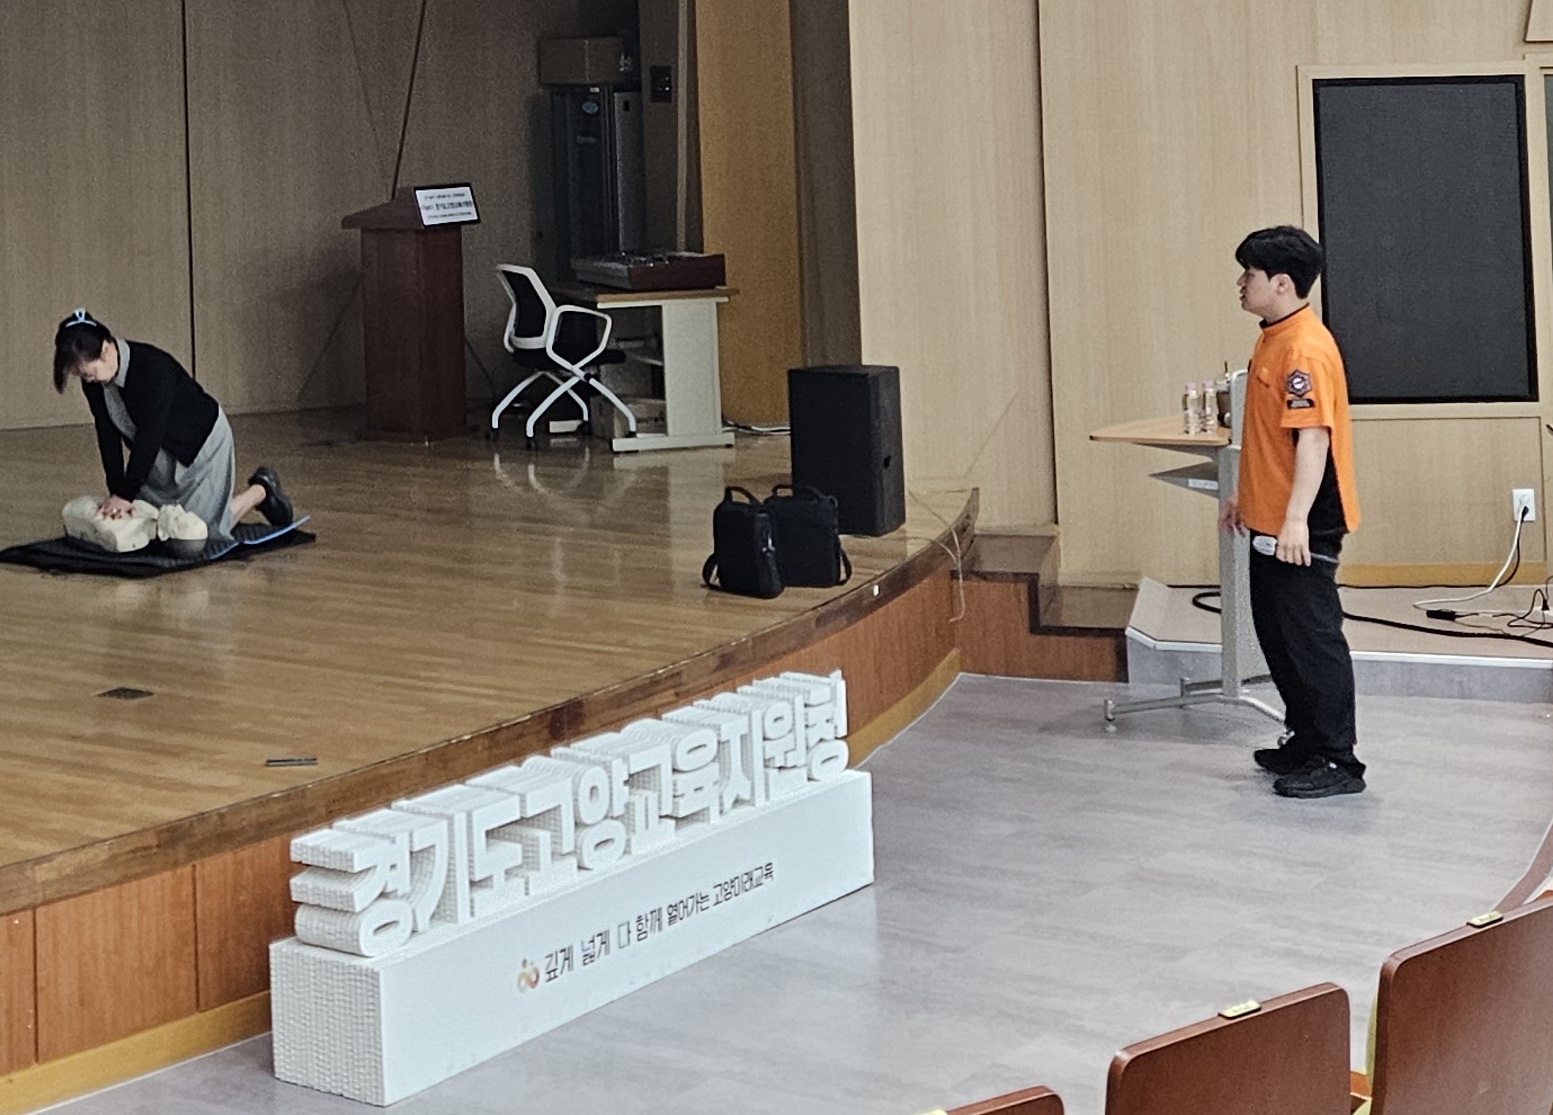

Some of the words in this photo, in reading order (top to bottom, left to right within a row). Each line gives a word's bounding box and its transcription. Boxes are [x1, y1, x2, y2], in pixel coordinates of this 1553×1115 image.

[290, 670, 851, 958] 경기도고양교육지원청
[545, 944, 574, 983] 깊게
[580, 929, 611, 966] 넓게
[617, 920, 631, 949] 다
[635, 907, 664, 942] 함께
[667, 892, 710, 926] 열어가는
[712, 862, 775, 907] 고양미래교육
